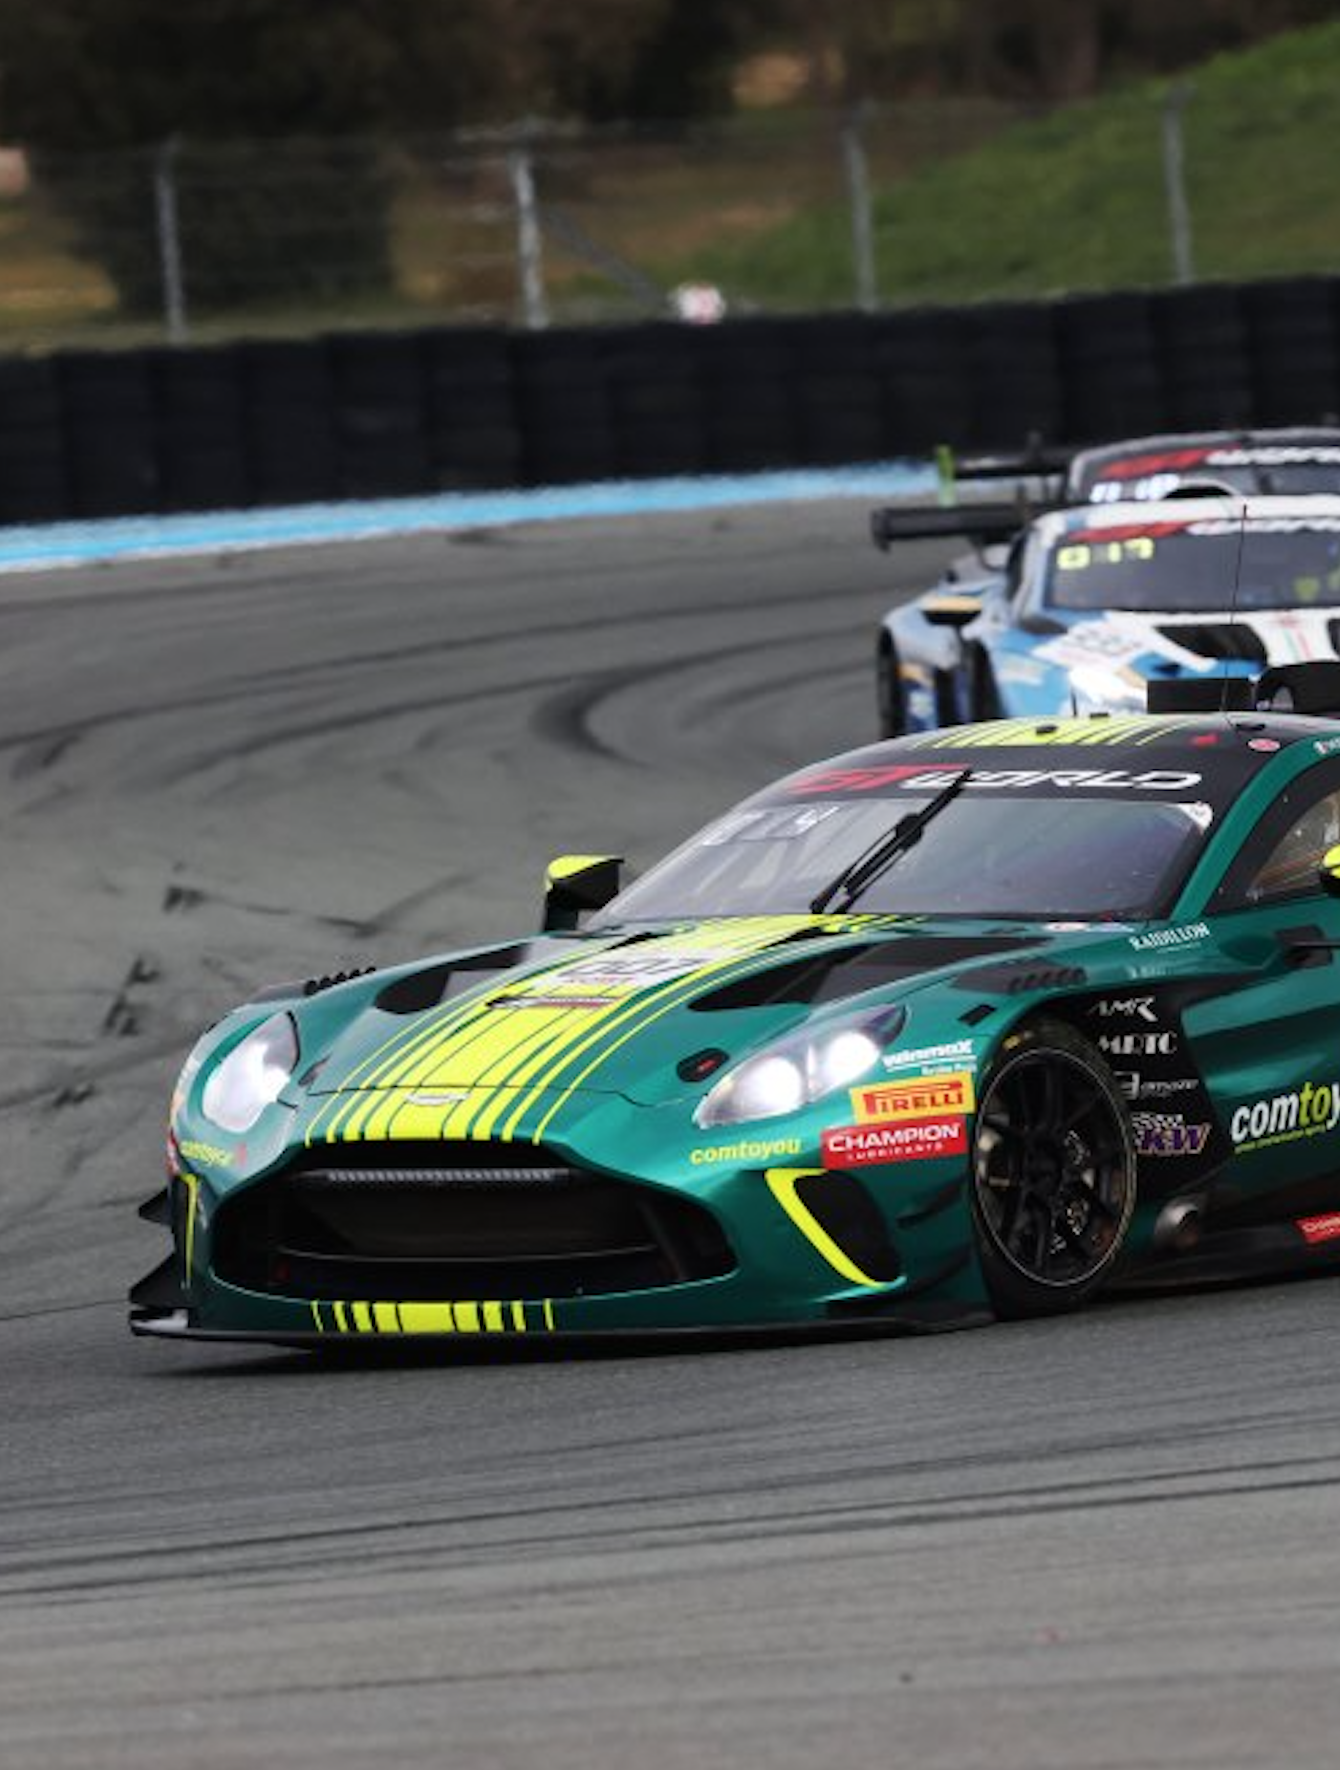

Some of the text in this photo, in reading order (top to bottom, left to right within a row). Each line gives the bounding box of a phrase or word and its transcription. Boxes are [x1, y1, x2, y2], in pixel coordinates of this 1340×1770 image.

[862, 1080, 964, 1116] PIRELLI
[689, 1138, 802, 1167] comtoyou
[827, 1123, 961, 1153] CHAMPION
